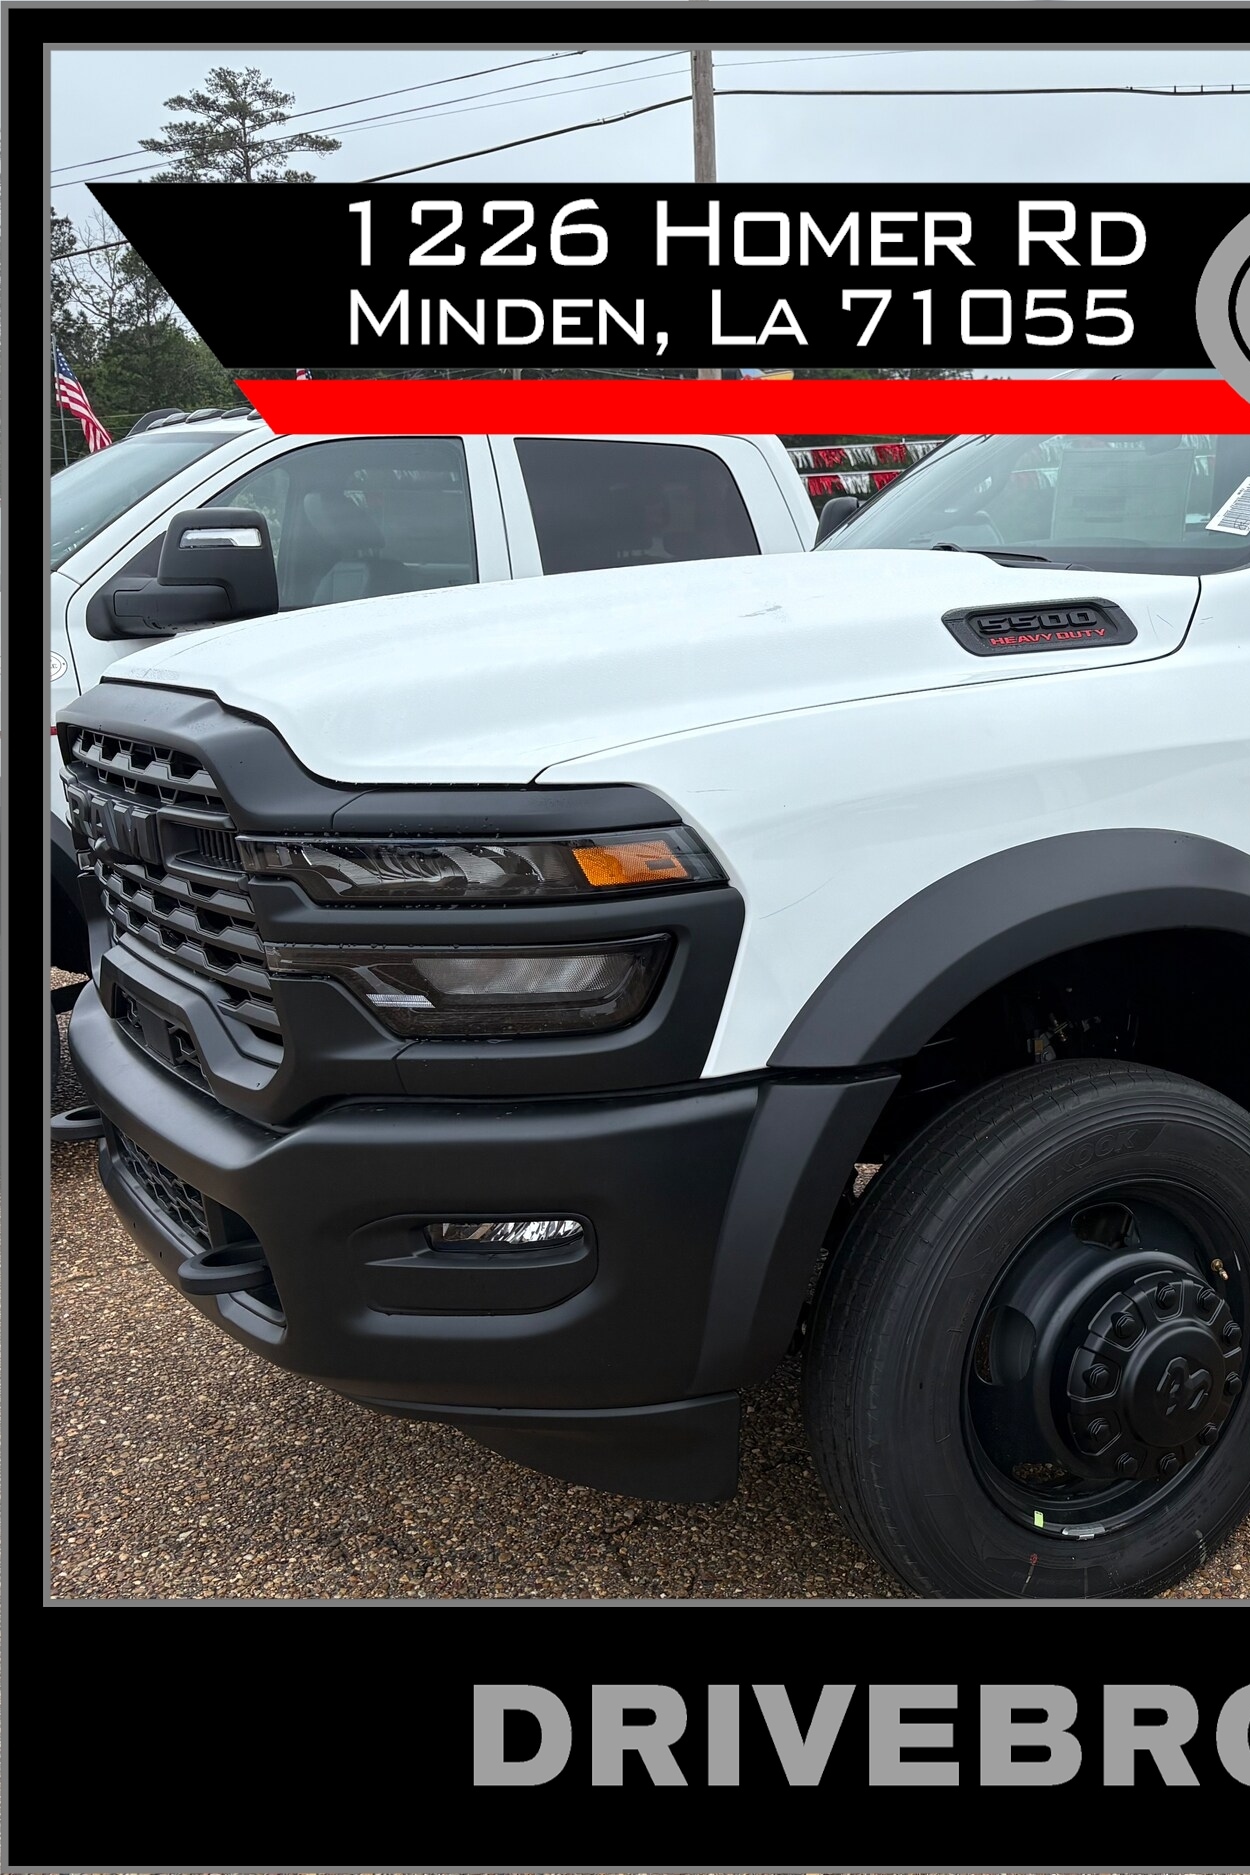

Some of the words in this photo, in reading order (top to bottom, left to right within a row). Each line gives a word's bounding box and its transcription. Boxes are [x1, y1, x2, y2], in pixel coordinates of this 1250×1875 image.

[977, 610, 1098, 635] 5500
[989, 633, 1053, 646] HEAVY
[1055, 628, 1107, 641] DUTY
[67, 783, 158, 866] RAM
